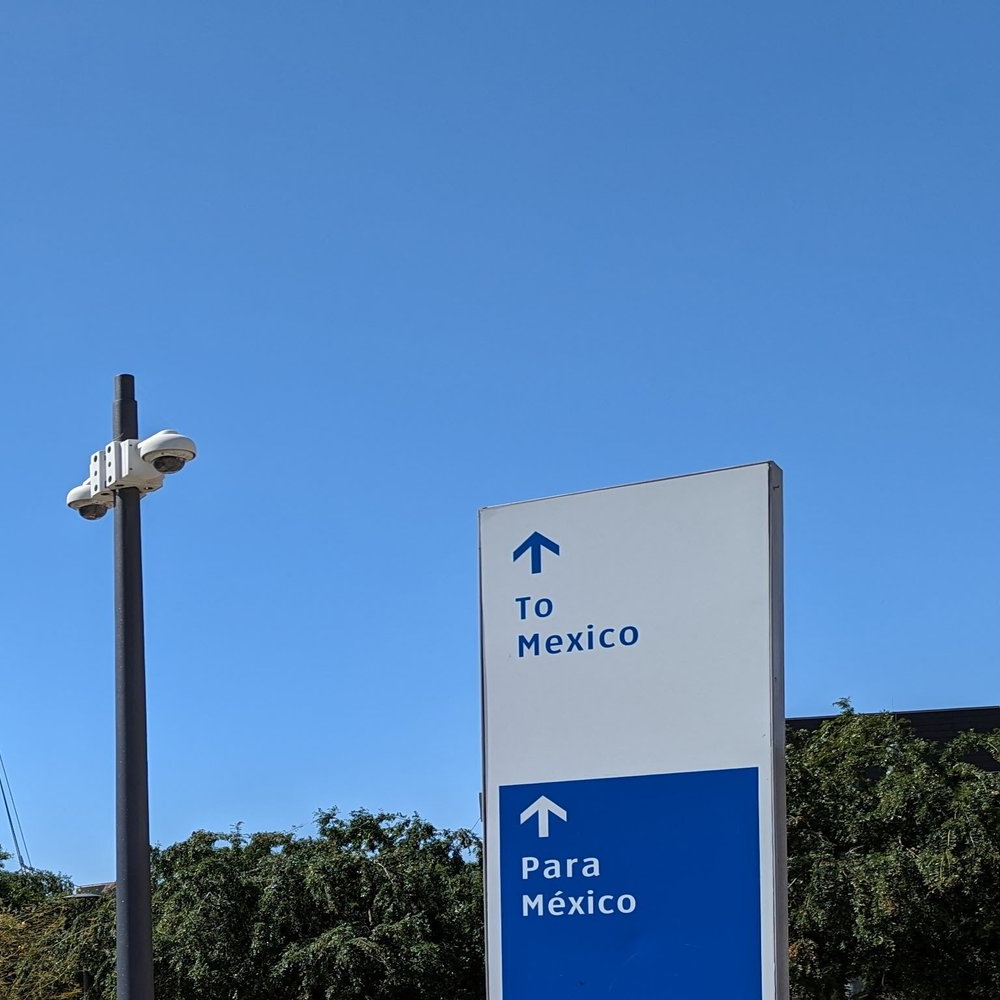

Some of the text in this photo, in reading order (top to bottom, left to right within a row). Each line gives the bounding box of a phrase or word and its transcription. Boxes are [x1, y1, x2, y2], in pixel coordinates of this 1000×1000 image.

[514, 596, 554, 620] To
[517, 624, 640, 658] Mexico
[521, 856, 601, 880] Para
[521, 889, 637, 917] México
